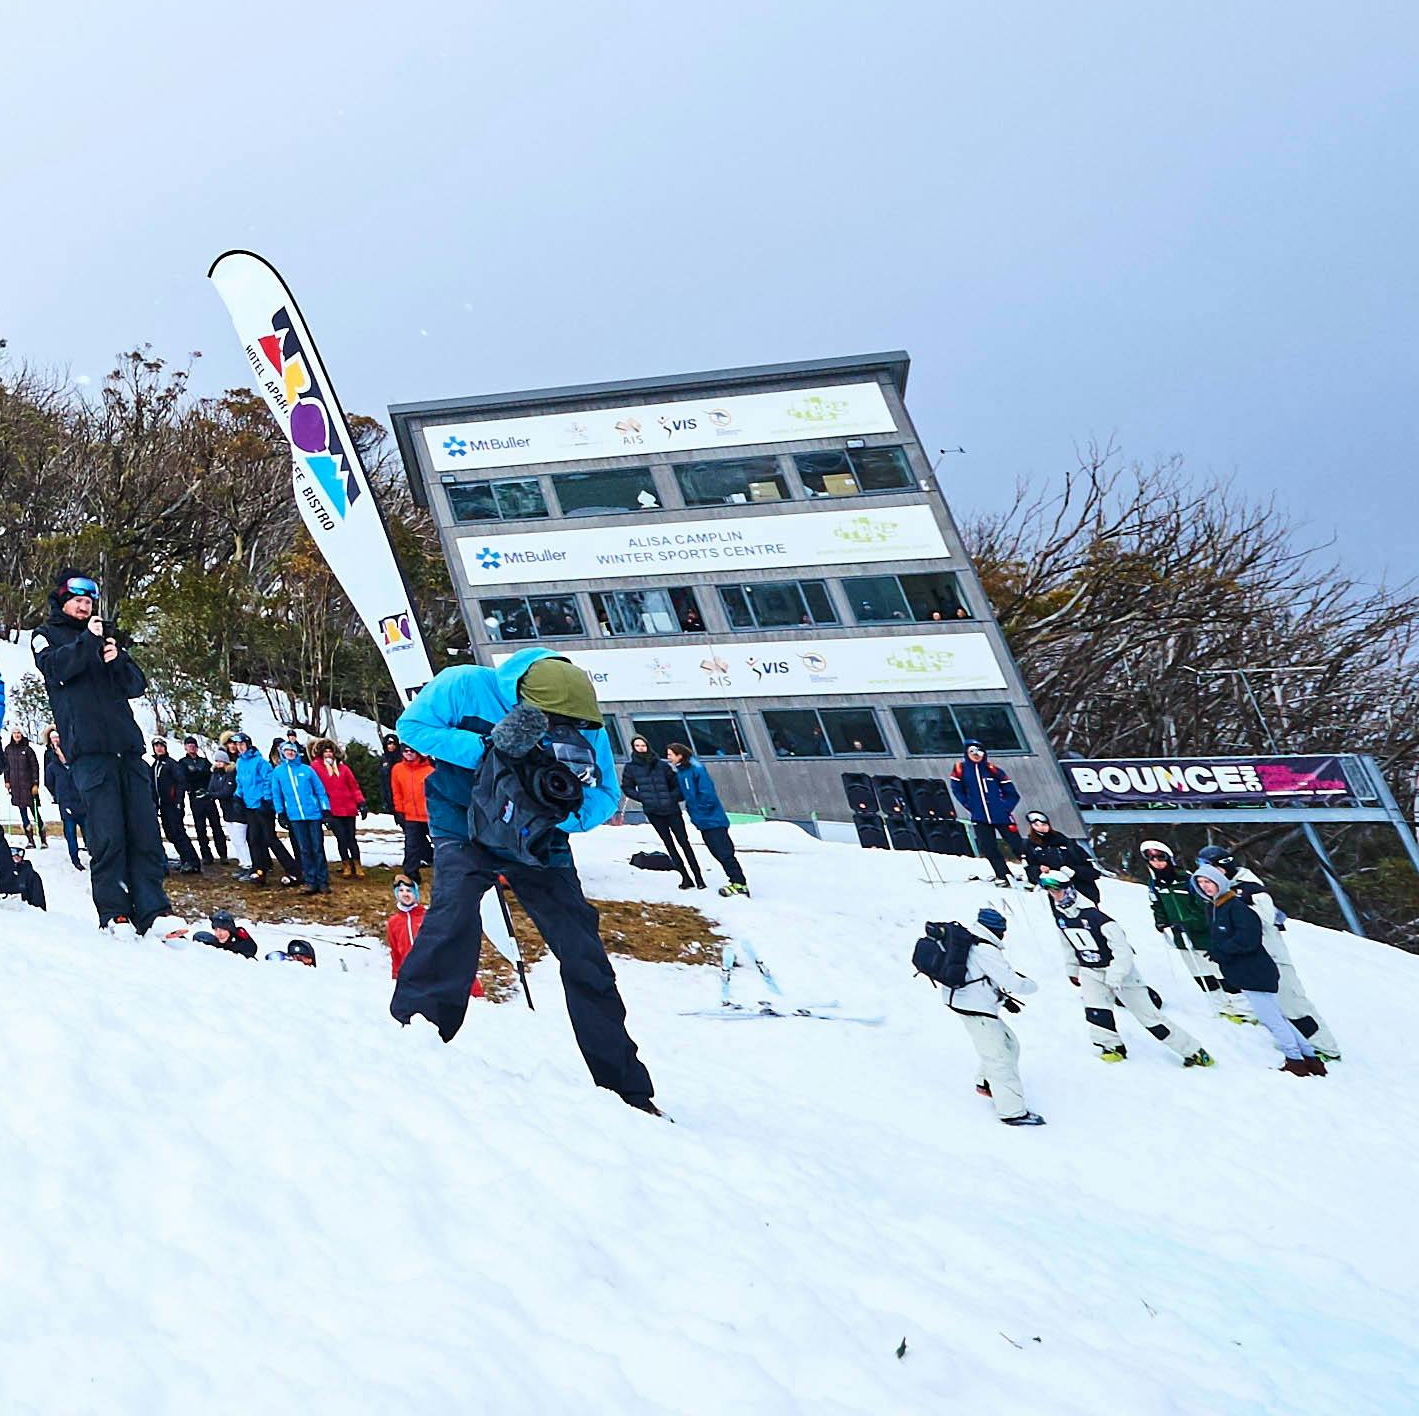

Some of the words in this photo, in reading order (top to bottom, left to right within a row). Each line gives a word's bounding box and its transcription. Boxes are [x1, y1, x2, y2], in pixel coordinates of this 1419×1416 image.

[672, 418, 697, 431] VIS
[623, 435, 644, 445] AIS
[302, 486, 335, 531] BISTRO
[628, 535, 671, 549] ALISA
[675, 530, 743, 545] CAMPLIN
[596, 552, 655, 566] WINTER
[658, 547, 719, 561] SPORTS
[723, 542, 787, 557] CENTRE
[762, 661, 790, 674] VIS
[709, 675, 732, 687] AIS
[1070, 765, 1247, 794] BOUNCE
